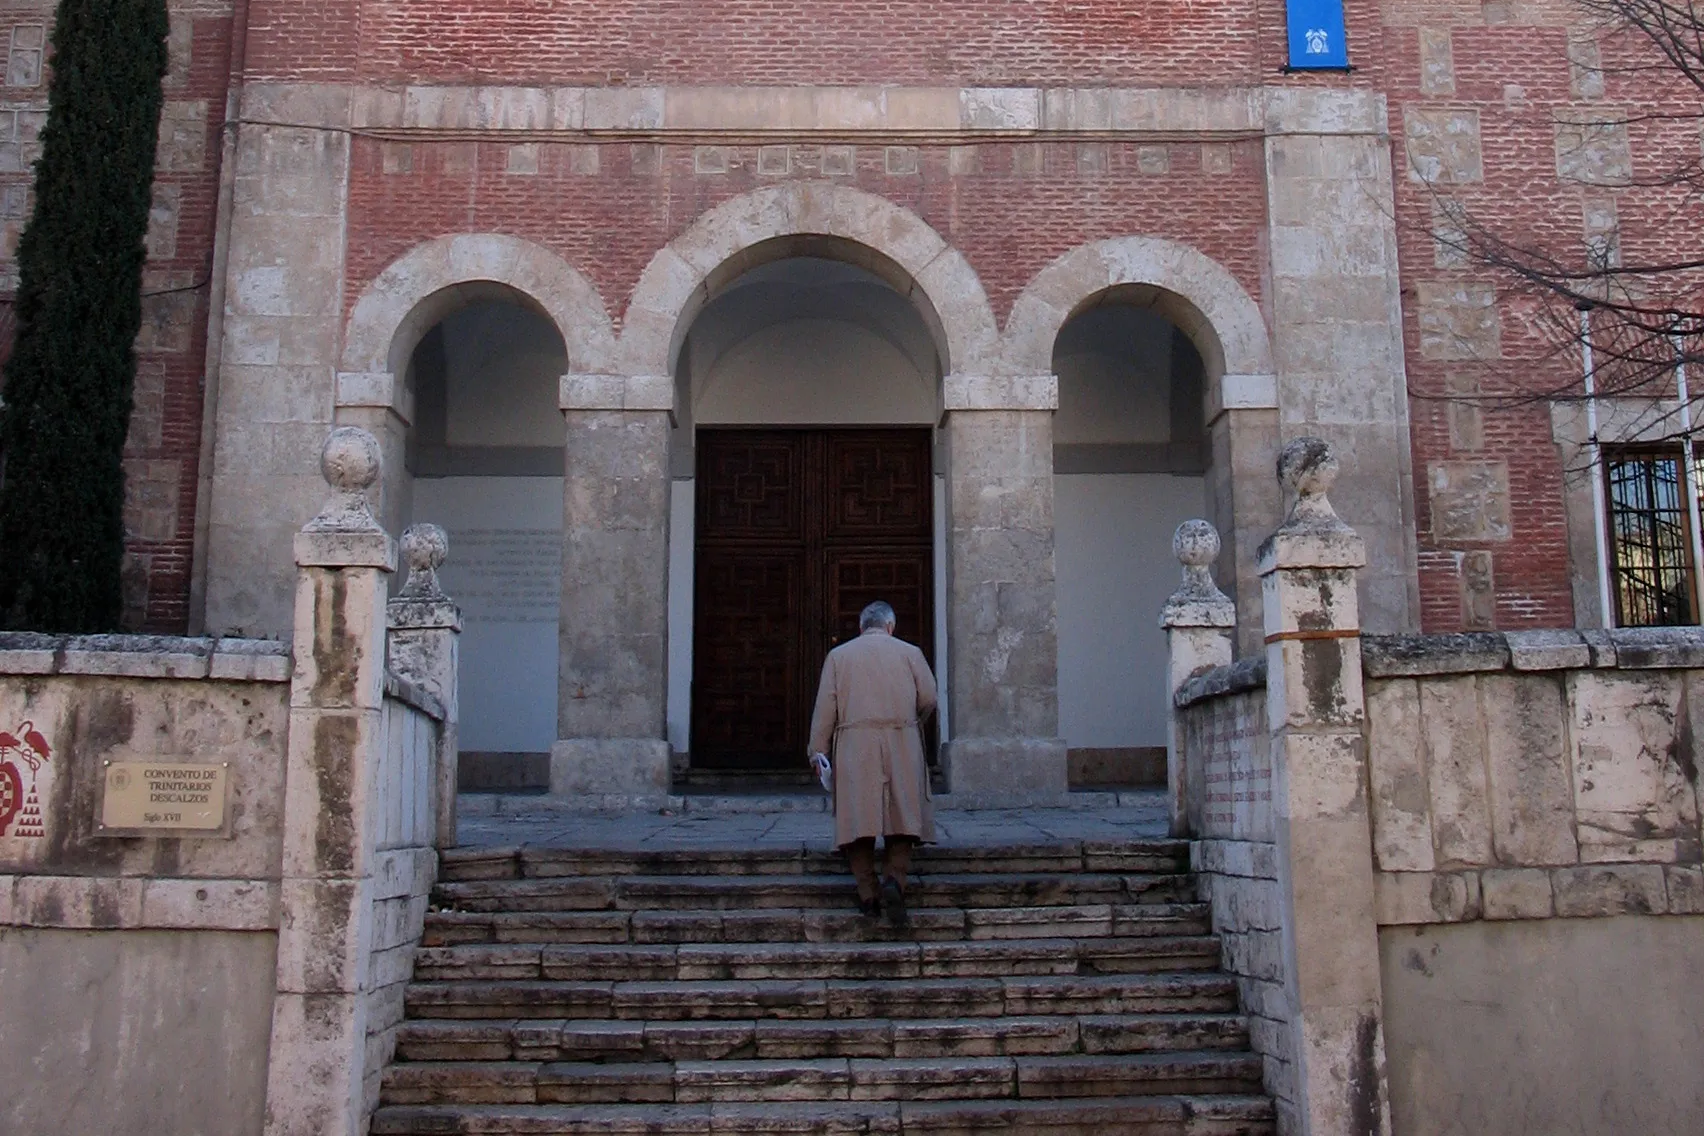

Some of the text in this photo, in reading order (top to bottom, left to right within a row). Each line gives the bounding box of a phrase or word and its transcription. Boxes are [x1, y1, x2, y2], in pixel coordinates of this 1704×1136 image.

[144, 769, 217, 779] CONVENTO DE
[149, 781, 212, 791] TRINITARIOS
[150, 793, 208, 803] DESCALZOS
[144, 812, 181, 823] Siglo XVII
